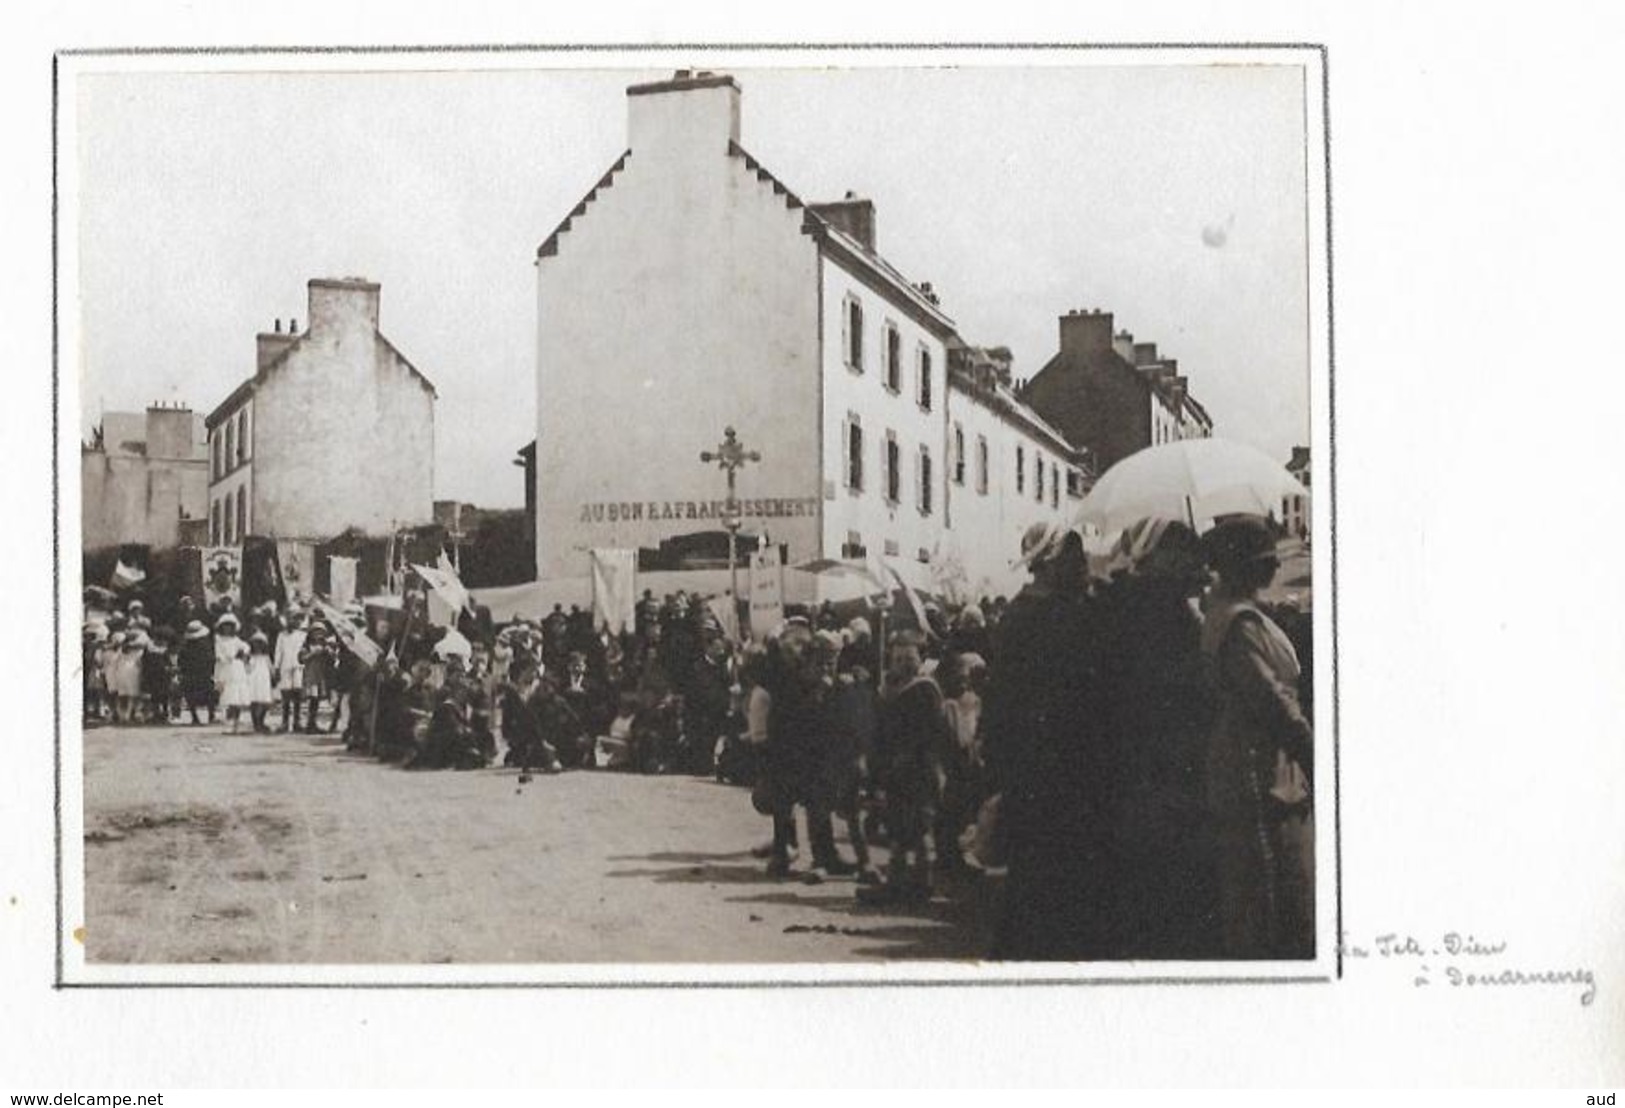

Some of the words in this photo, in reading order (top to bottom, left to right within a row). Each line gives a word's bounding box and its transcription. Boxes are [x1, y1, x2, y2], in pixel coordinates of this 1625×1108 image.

[579, 502, 605, 523] AU
[607, 501, 644, 522] BON
[1444, 965, 1597, 1008] Douarnenez
